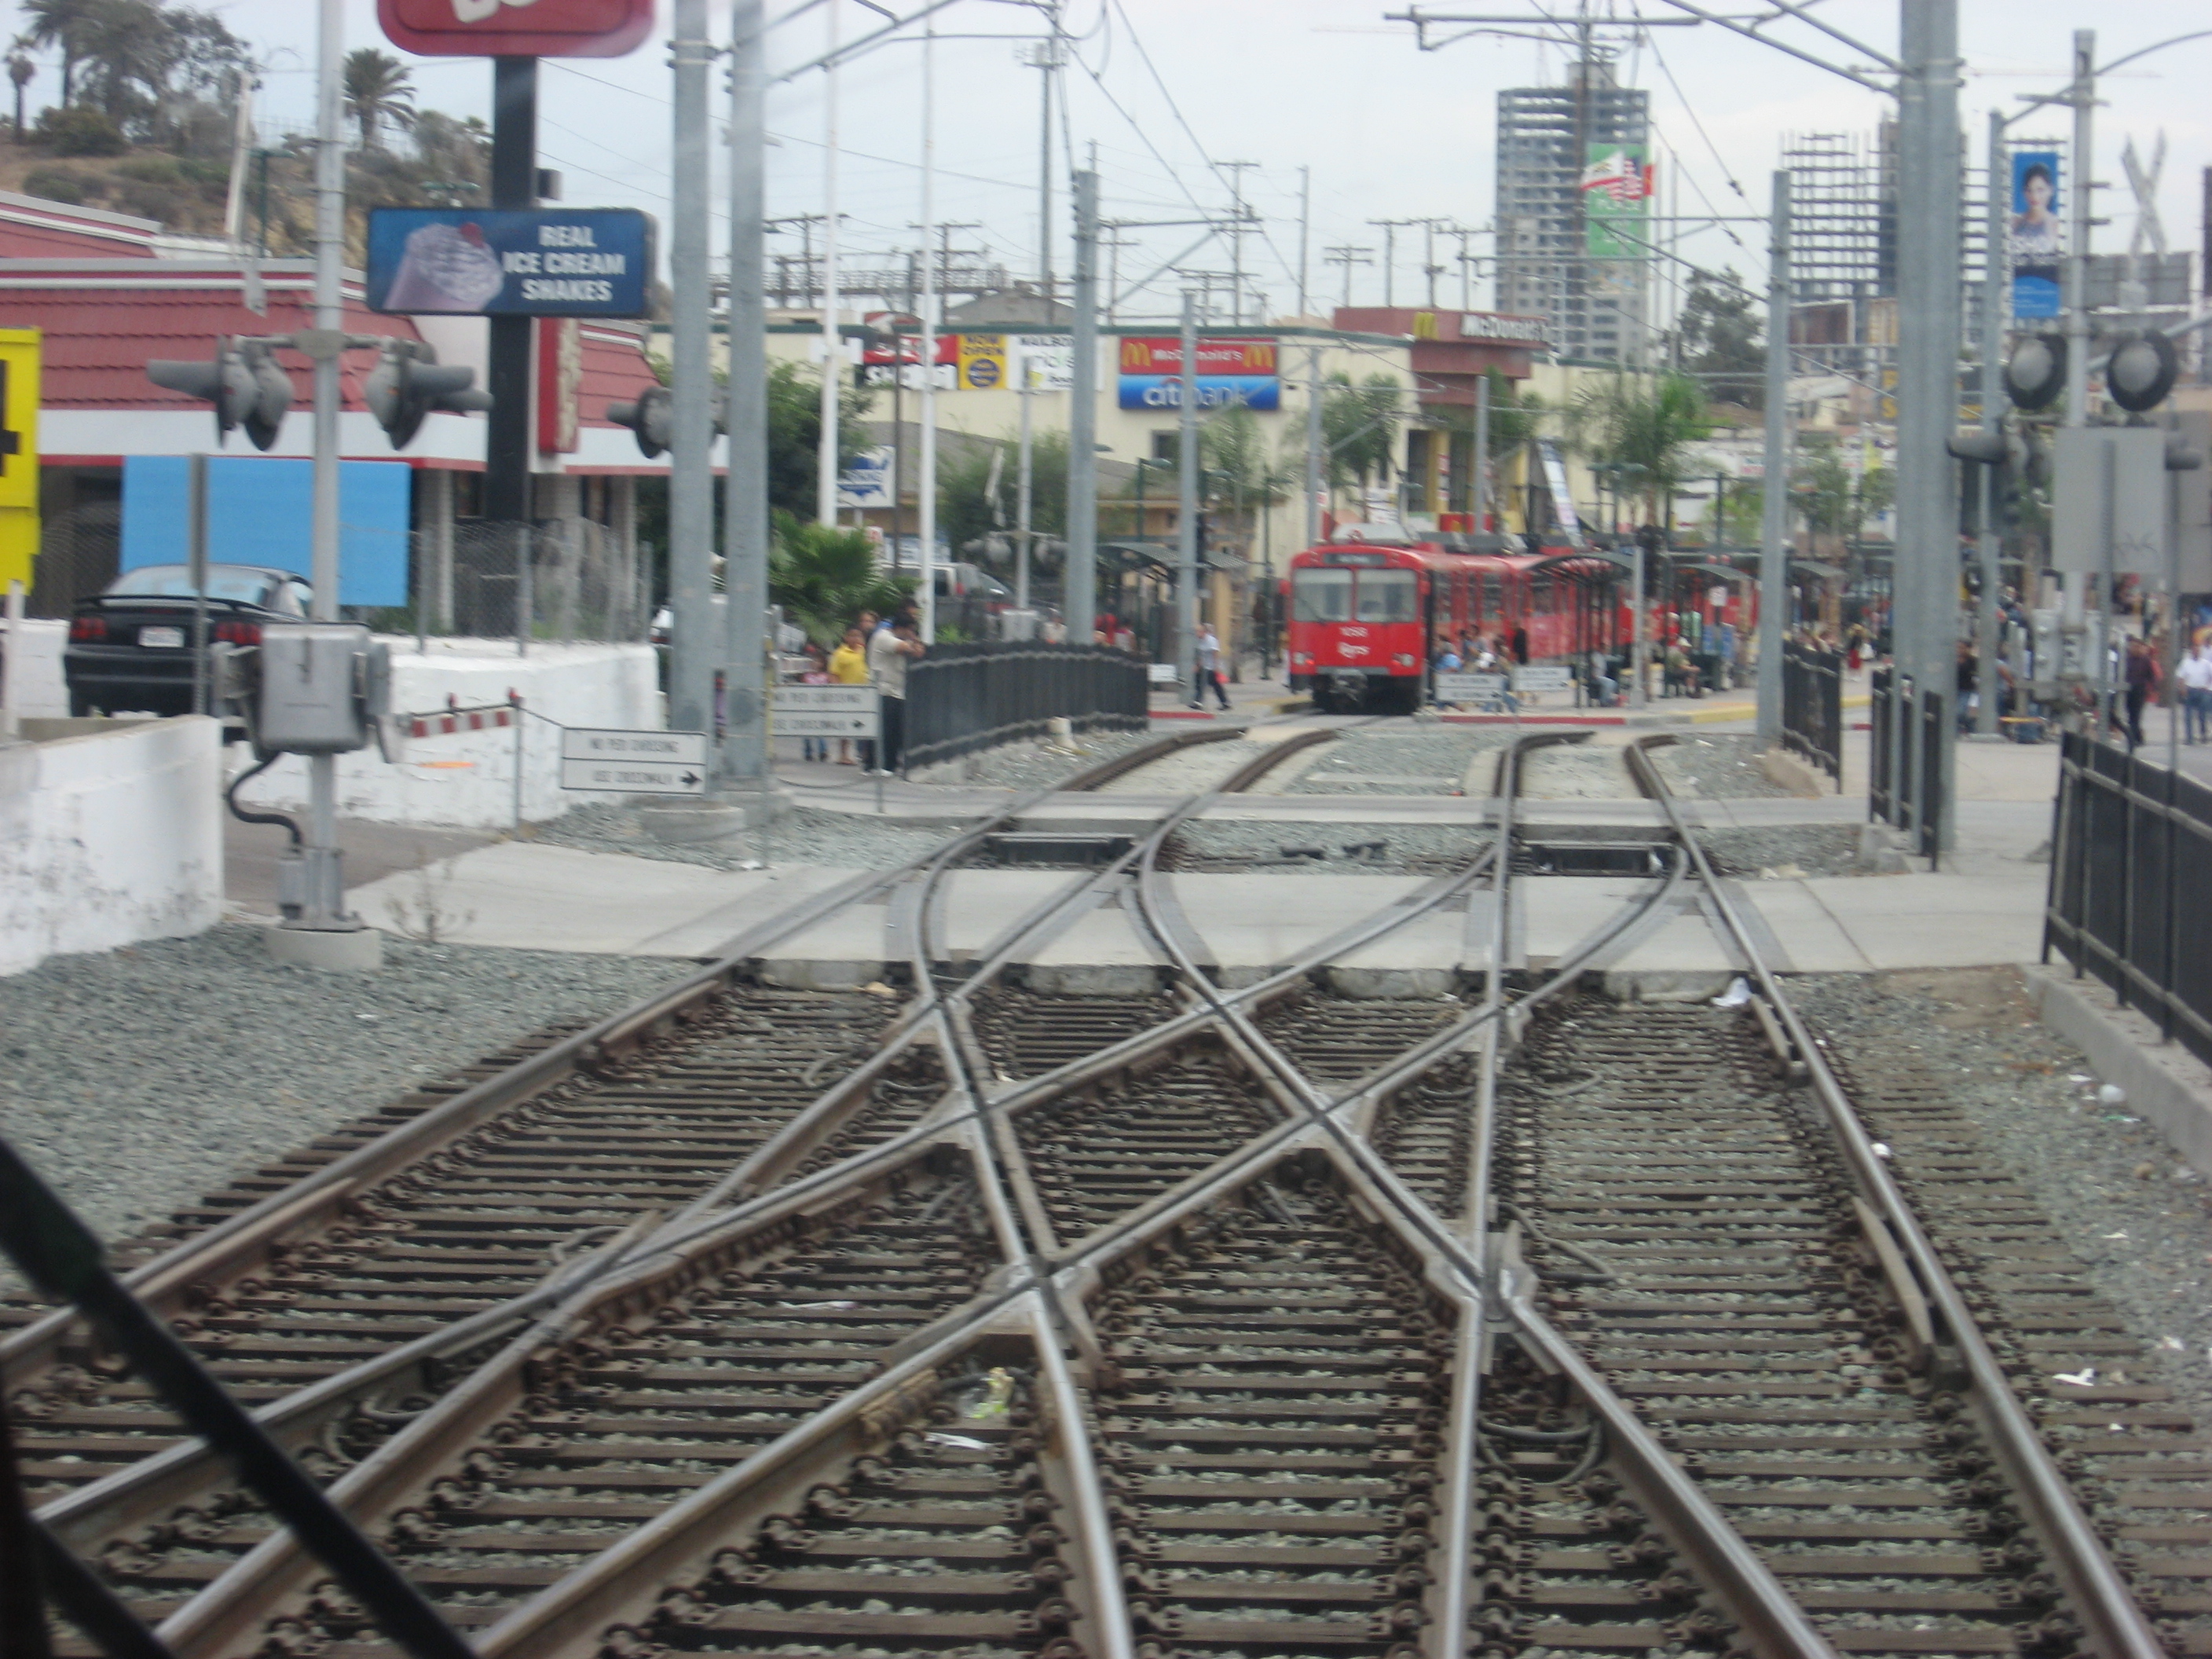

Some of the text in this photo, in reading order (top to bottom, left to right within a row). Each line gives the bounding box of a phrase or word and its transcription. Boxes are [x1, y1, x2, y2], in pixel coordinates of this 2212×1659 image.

[539, 225, 598, 248] REAL
[501, 251, 626, 275] ICE CREAM
[521, 279, 613, 302] SHAKES
[962, 346, 1005, 356] OPEN
[1152, 348, 1243, 361] McDnald's
[1143, 381, 1248, 406] citank
